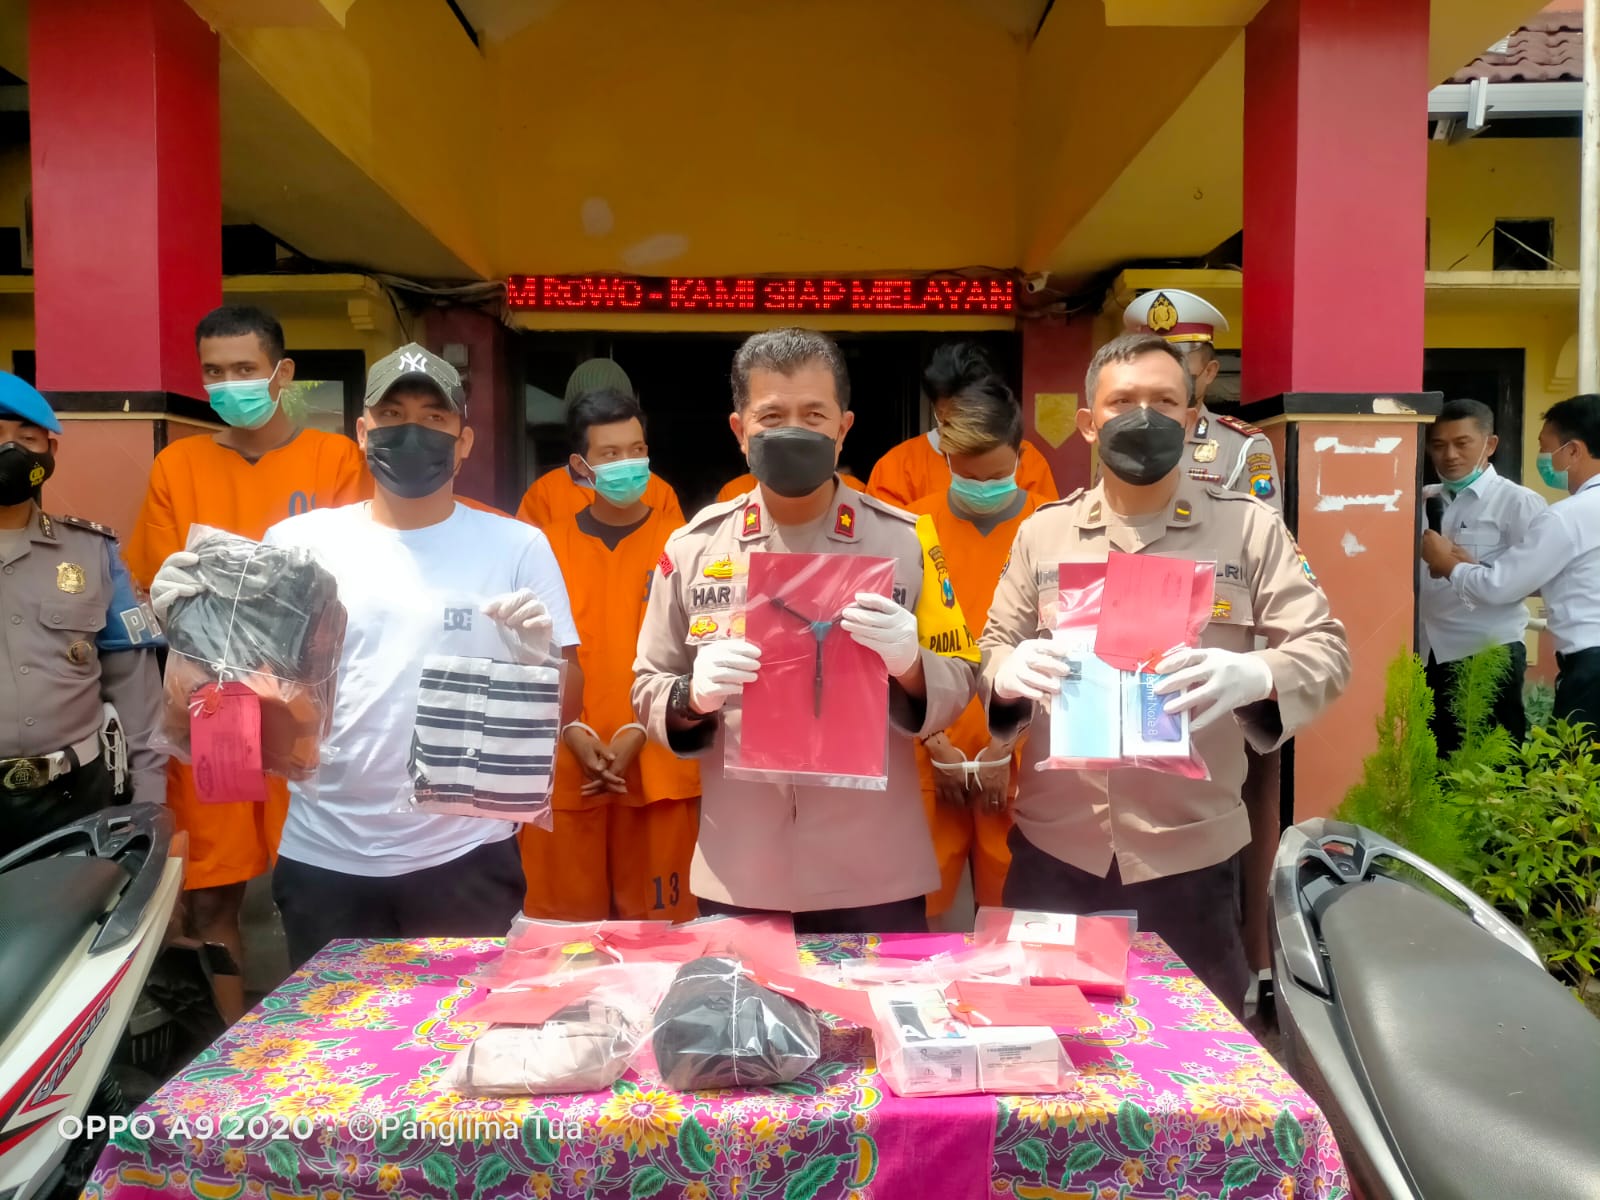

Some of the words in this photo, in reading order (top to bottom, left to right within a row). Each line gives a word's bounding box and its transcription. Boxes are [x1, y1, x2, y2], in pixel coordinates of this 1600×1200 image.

[544, 277, 642, 306] ROWO
[671, 279, 754, 308] KAMI
[764, 280, 846, 308] SIAP
[852, 280, 1012, 310] MELAYAN
[398, 352, 427, 373] NY
[929, 629, 962, 653] PADAL
[1147, 702, 1158, 727] Note
[652, 871, 680, 911] 13
